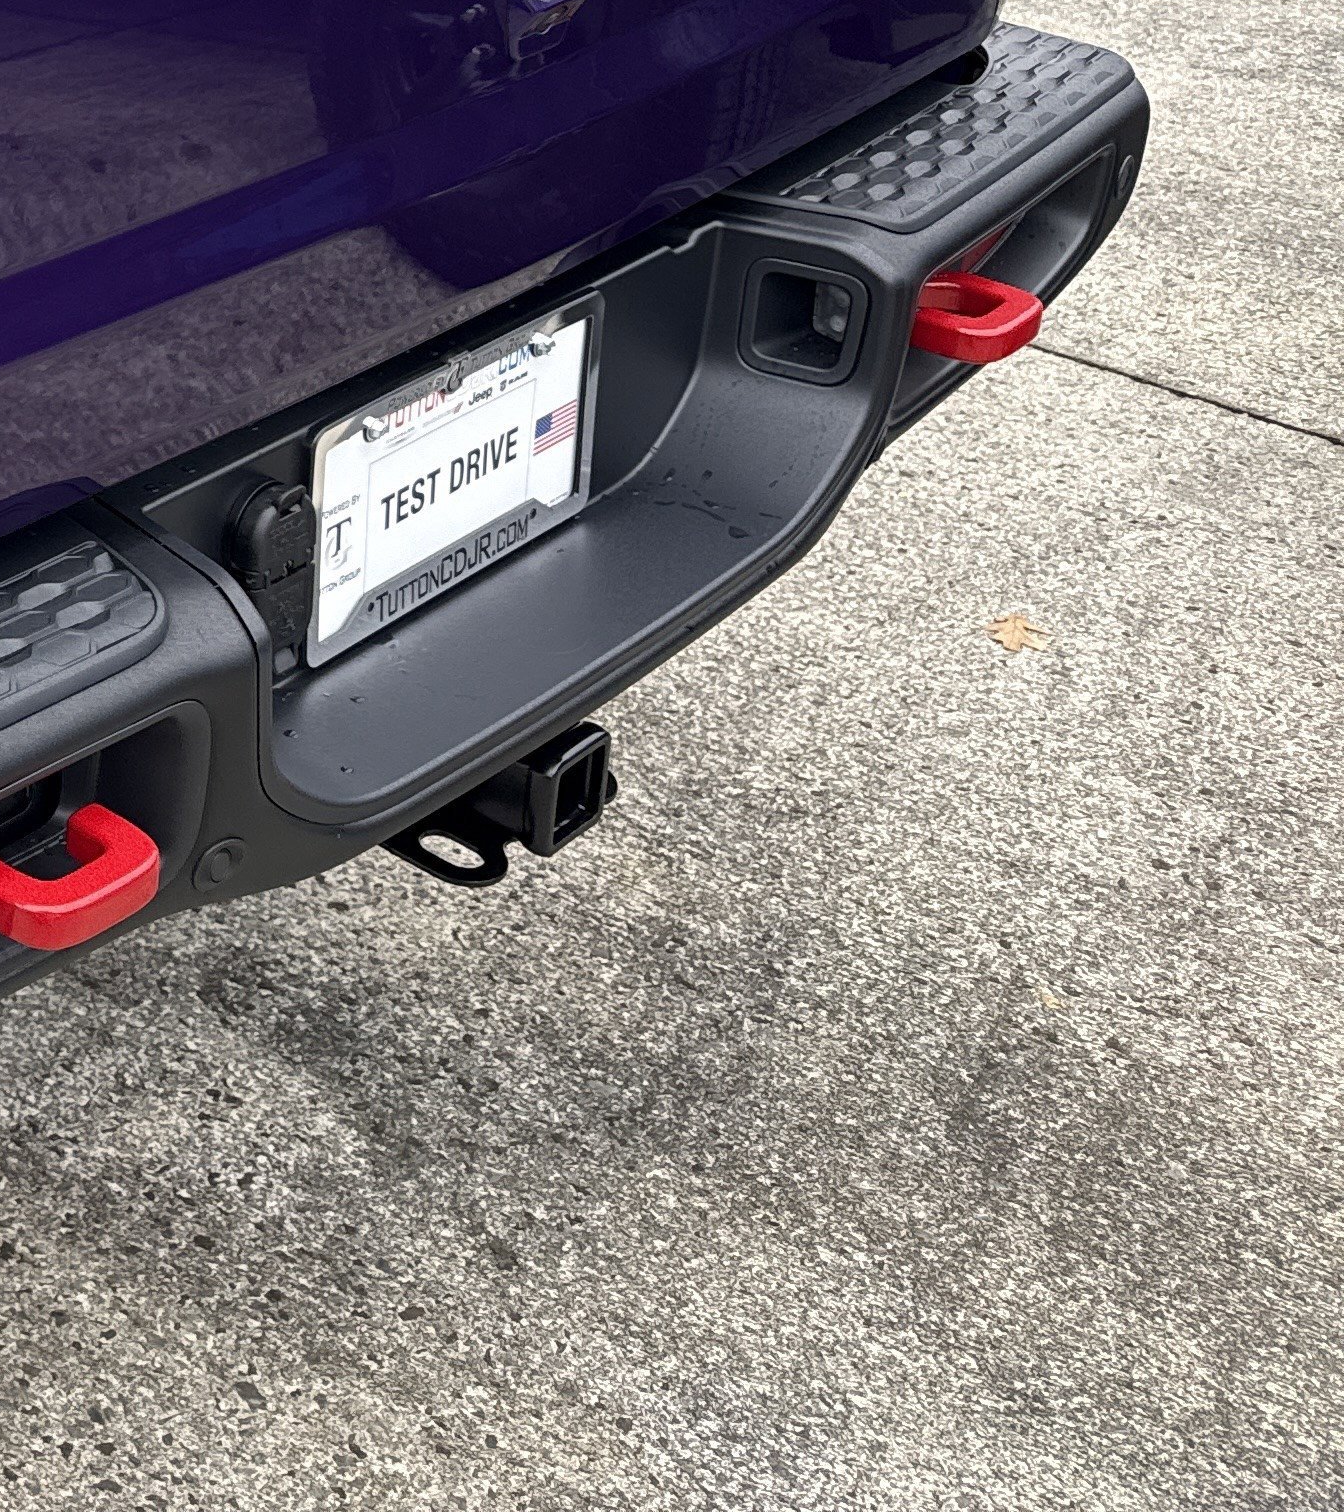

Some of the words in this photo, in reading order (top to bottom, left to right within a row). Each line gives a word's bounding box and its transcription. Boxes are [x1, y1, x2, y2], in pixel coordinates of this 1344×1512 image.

[468, 387, 493, 406] Jeep
[380, 467, 441, 530] TEST
[449, 426, 519, 494] DRIVE
[375, 514, 529, 622] TUTTONCDJR.COM
